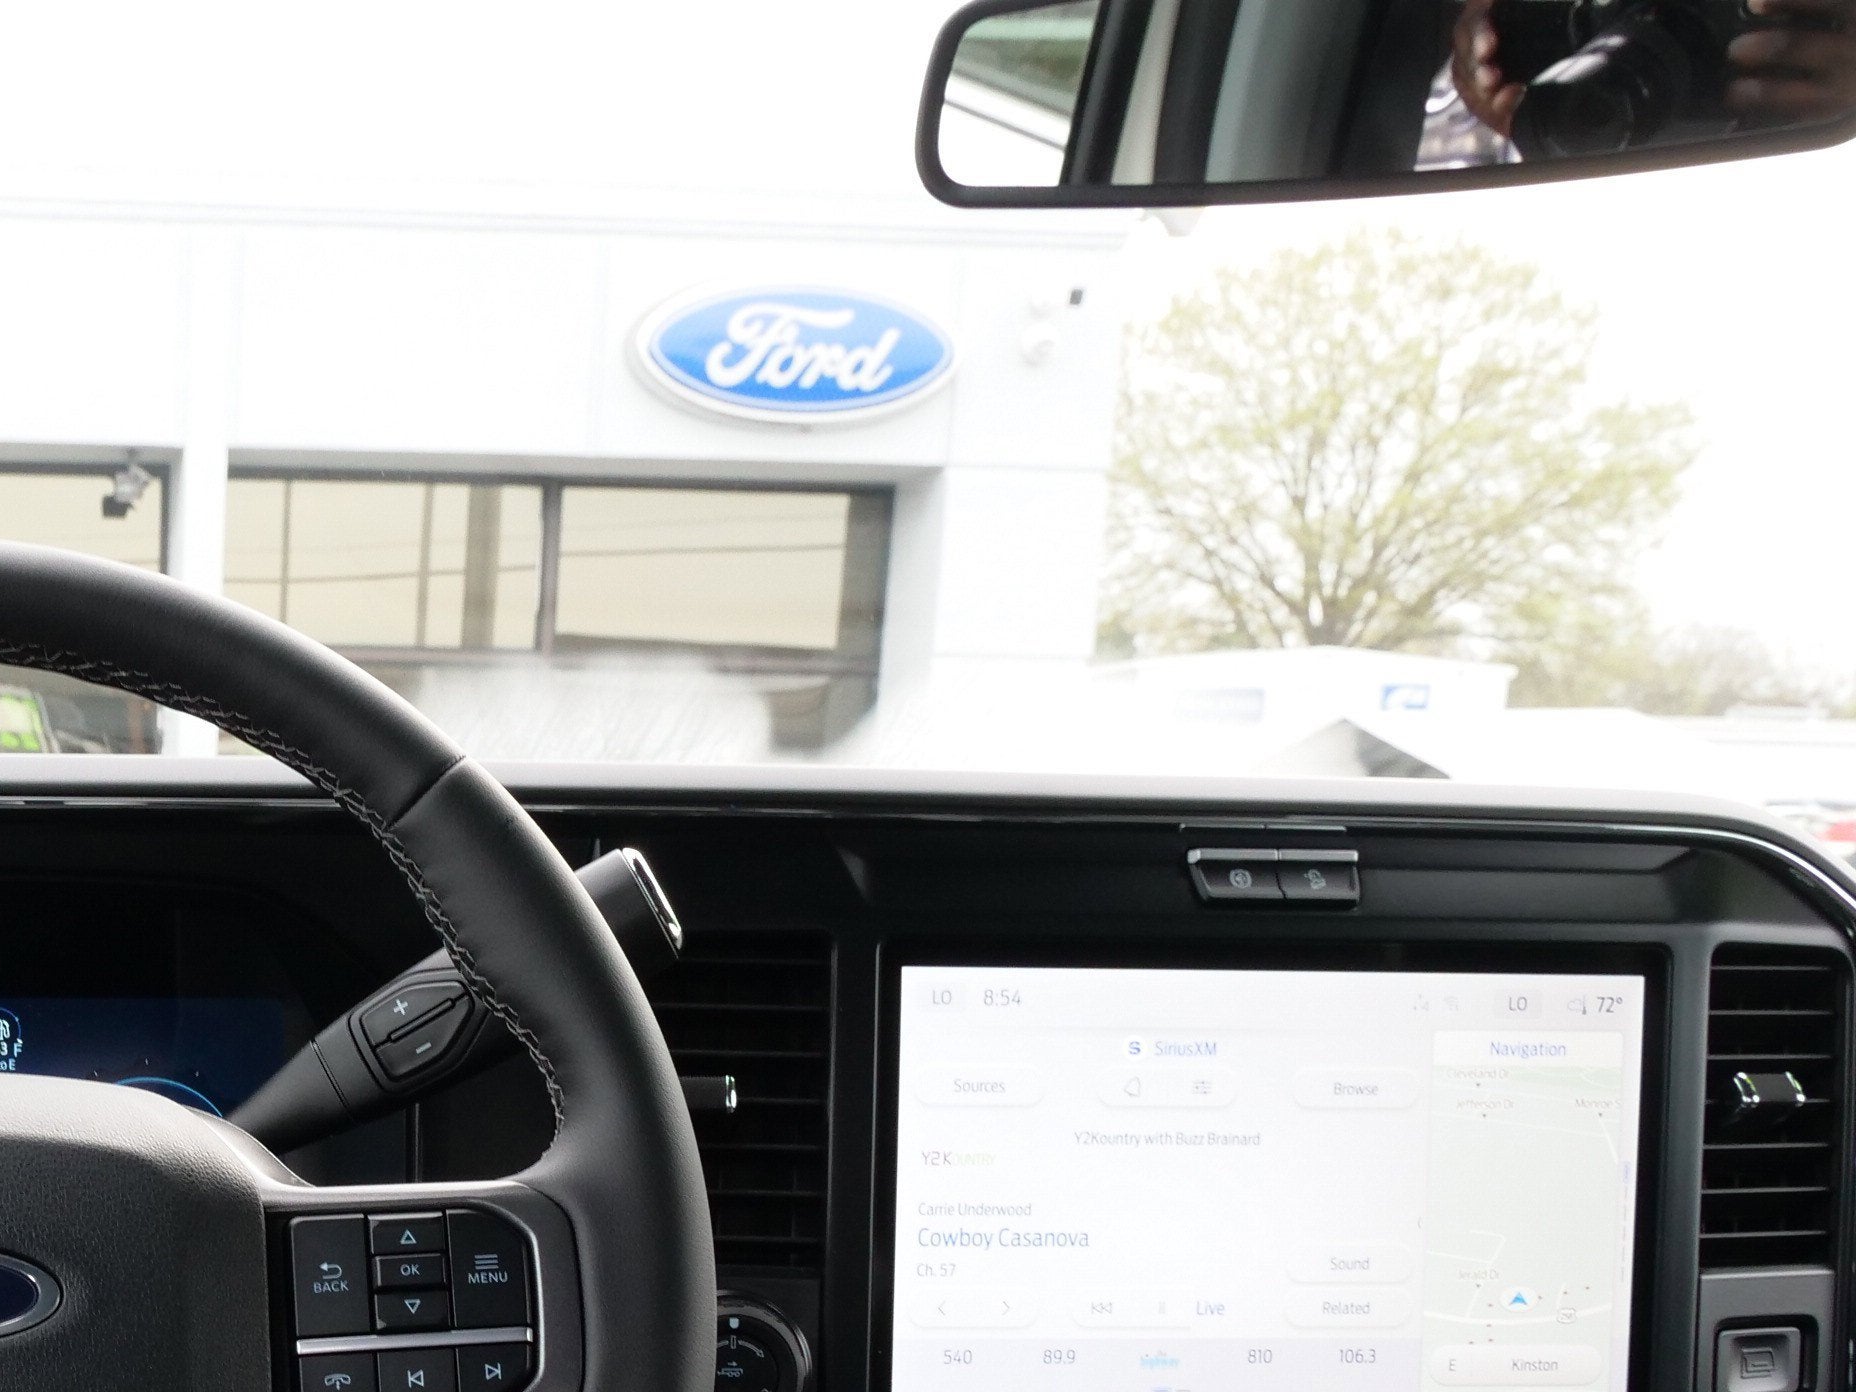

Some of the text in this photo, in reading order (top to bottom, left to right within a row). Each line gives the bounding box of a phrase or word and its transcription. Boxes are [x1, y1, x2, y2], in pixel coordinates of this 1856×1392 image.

[704, 302, 903, 392] Ford
[931, 990, 953, 1005] LO
[982, 989, 1023, 1006] 8:54
[1508, 997, 1528, 1012] LO
[1154, 1041, 1218, 1057] SiriusXM
[1490, 1042, 1567, 1059] Navigation
[8, 1060, 16, 1070] E
[953, 1079, 1007, 1094] Sources
[1333, 1083, 1379, 1096] Browse
[1143, 1131, 1173, 1146] with
[1175, 1131, 1205, 1146] Buzz
[1207, 1131, 1262, 1147] Brainard
[918, 1202, 1033, 1217] Carrie Underwood
[917, 1228, 1091, 1250] Cowboy Casanova
[399, 1263, 420, 1276] OK
[939, 1263, 957, 1277] 57
[1329, 1256, 1370, 1271] Sound
[467, 1271, 509, 1285] MENU
[312, 1280, 349, 1294] BACK
[1196, 1302, 1225, 1316] Live
[1322, 1302, 1371, 1316] Related
[943, 1350, 973, 1365] 540
[1043, 1349, 1076, 1365] 89.9
[1247, 1349, 1273, 1364] 810
[1339, 1349, 1377, 1364] 106.3
[1448, 1360, 1457, 1372] E
[1512, 1358, 1559, 1372] Kinston
